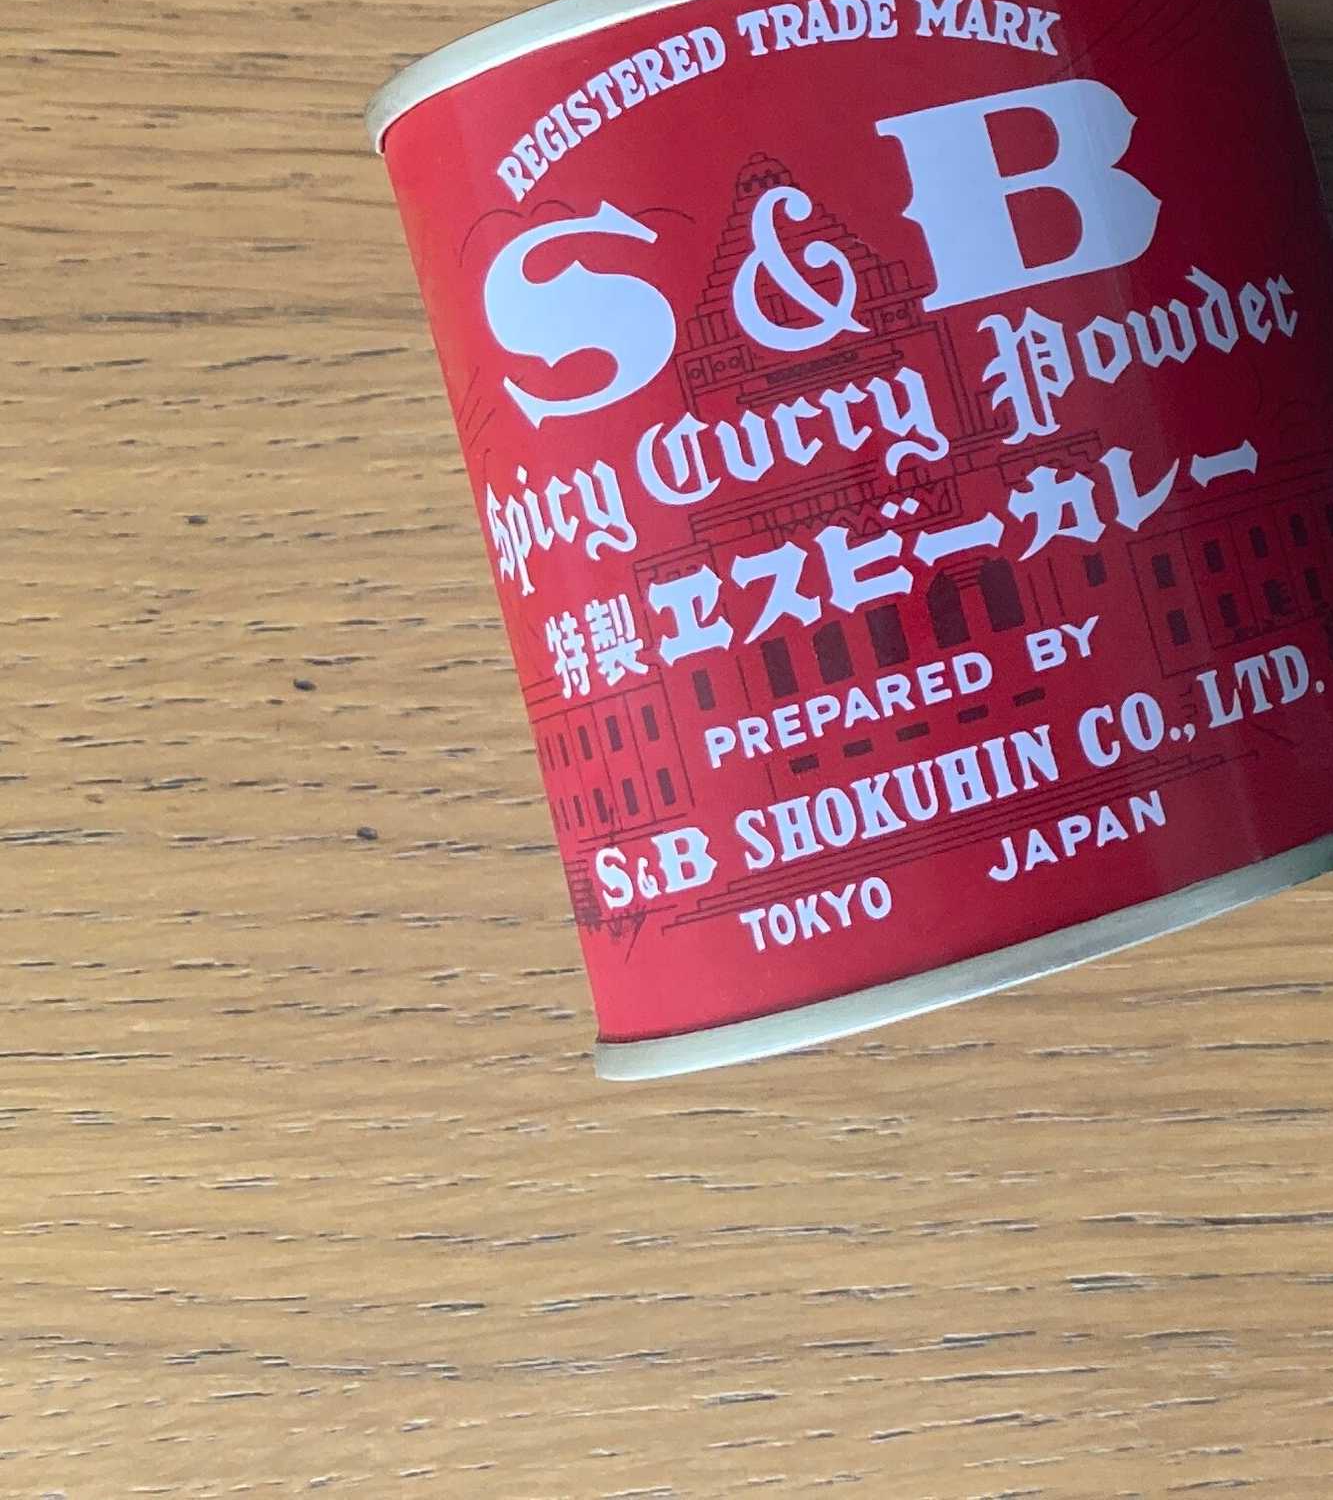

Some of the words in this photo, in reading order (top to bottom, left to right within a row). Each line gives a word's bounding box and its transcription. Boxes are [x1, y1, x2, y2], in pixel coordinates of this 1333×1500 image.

[496, 25, 727, 203] REGISTERED
[486, 460, 637, 596] Spicy
[636, 366, 950, 506] Curry
[976, 263, 1300, 447] Powder
[704, 652, 994, 769] PREPARED
[1026, 615, 1100, 673] BY
[596, 826, 718, 910] S&B
[733, 724, 1061, 871] SHOKUHIN
[739, 876, 894, 953] TOKYO
[988, 789, 1168, 883] JAPAN
